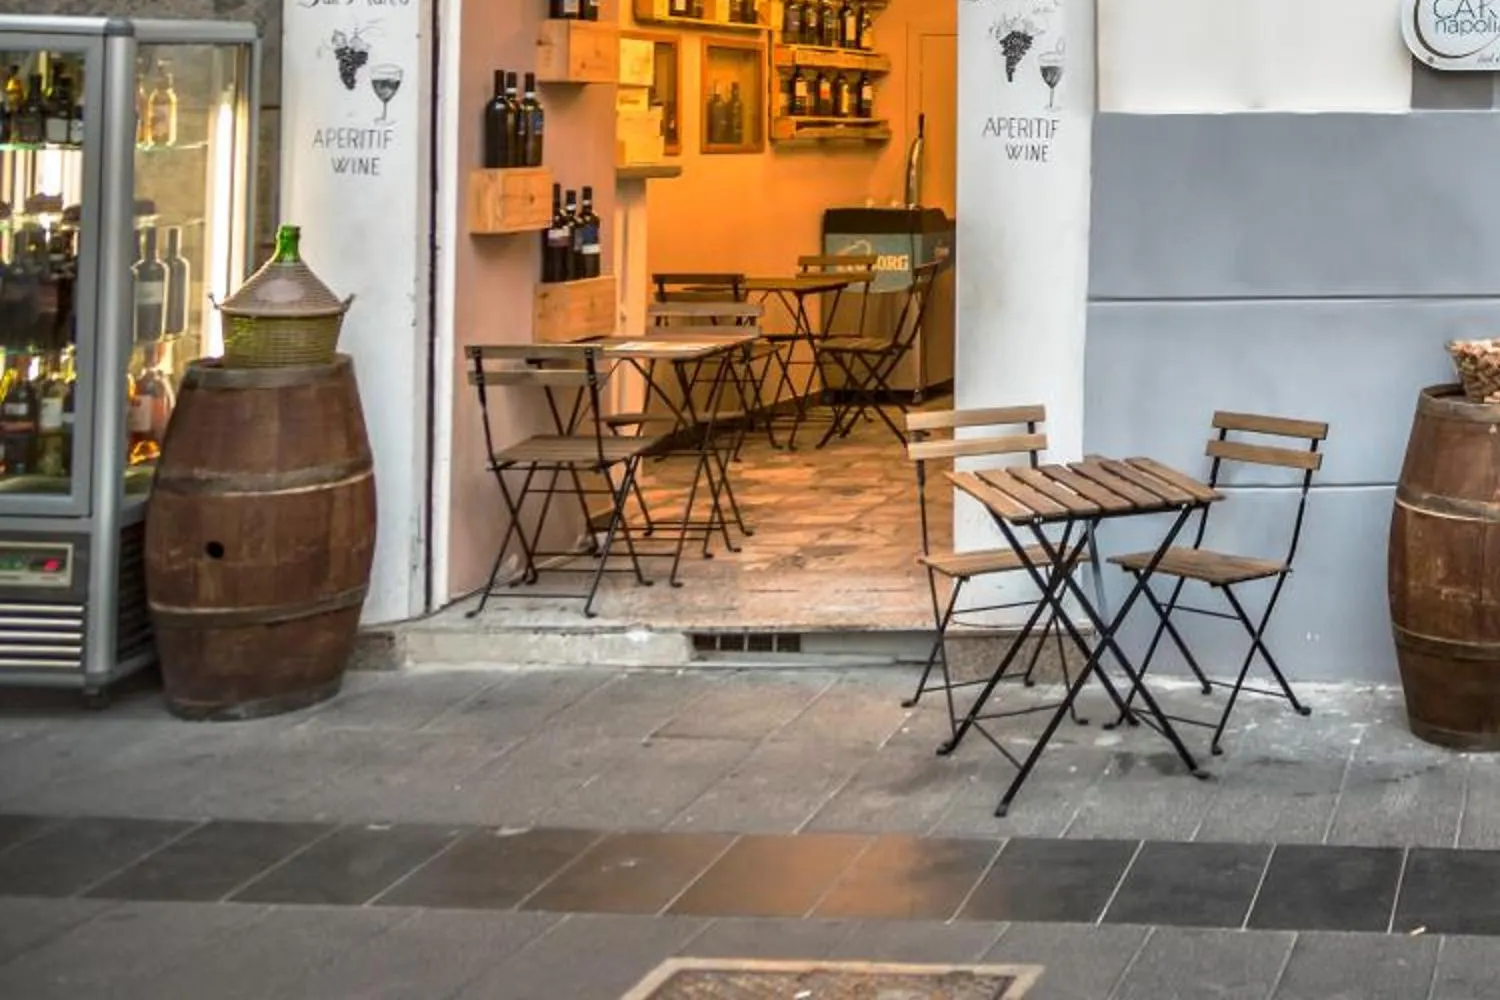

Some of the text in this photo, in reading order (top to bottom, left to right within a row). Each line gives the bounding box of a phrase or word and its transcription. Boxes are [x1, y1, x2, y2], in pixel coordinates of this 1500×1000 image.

[1434, 17, 1497, 37] napoli
[312, 127, 394, 150] APERITIF
[982, 117, 1061, 140] APERITIF
[1005, 144, 1049, 163] WINE
[330, 156, 381, 176] WINE
